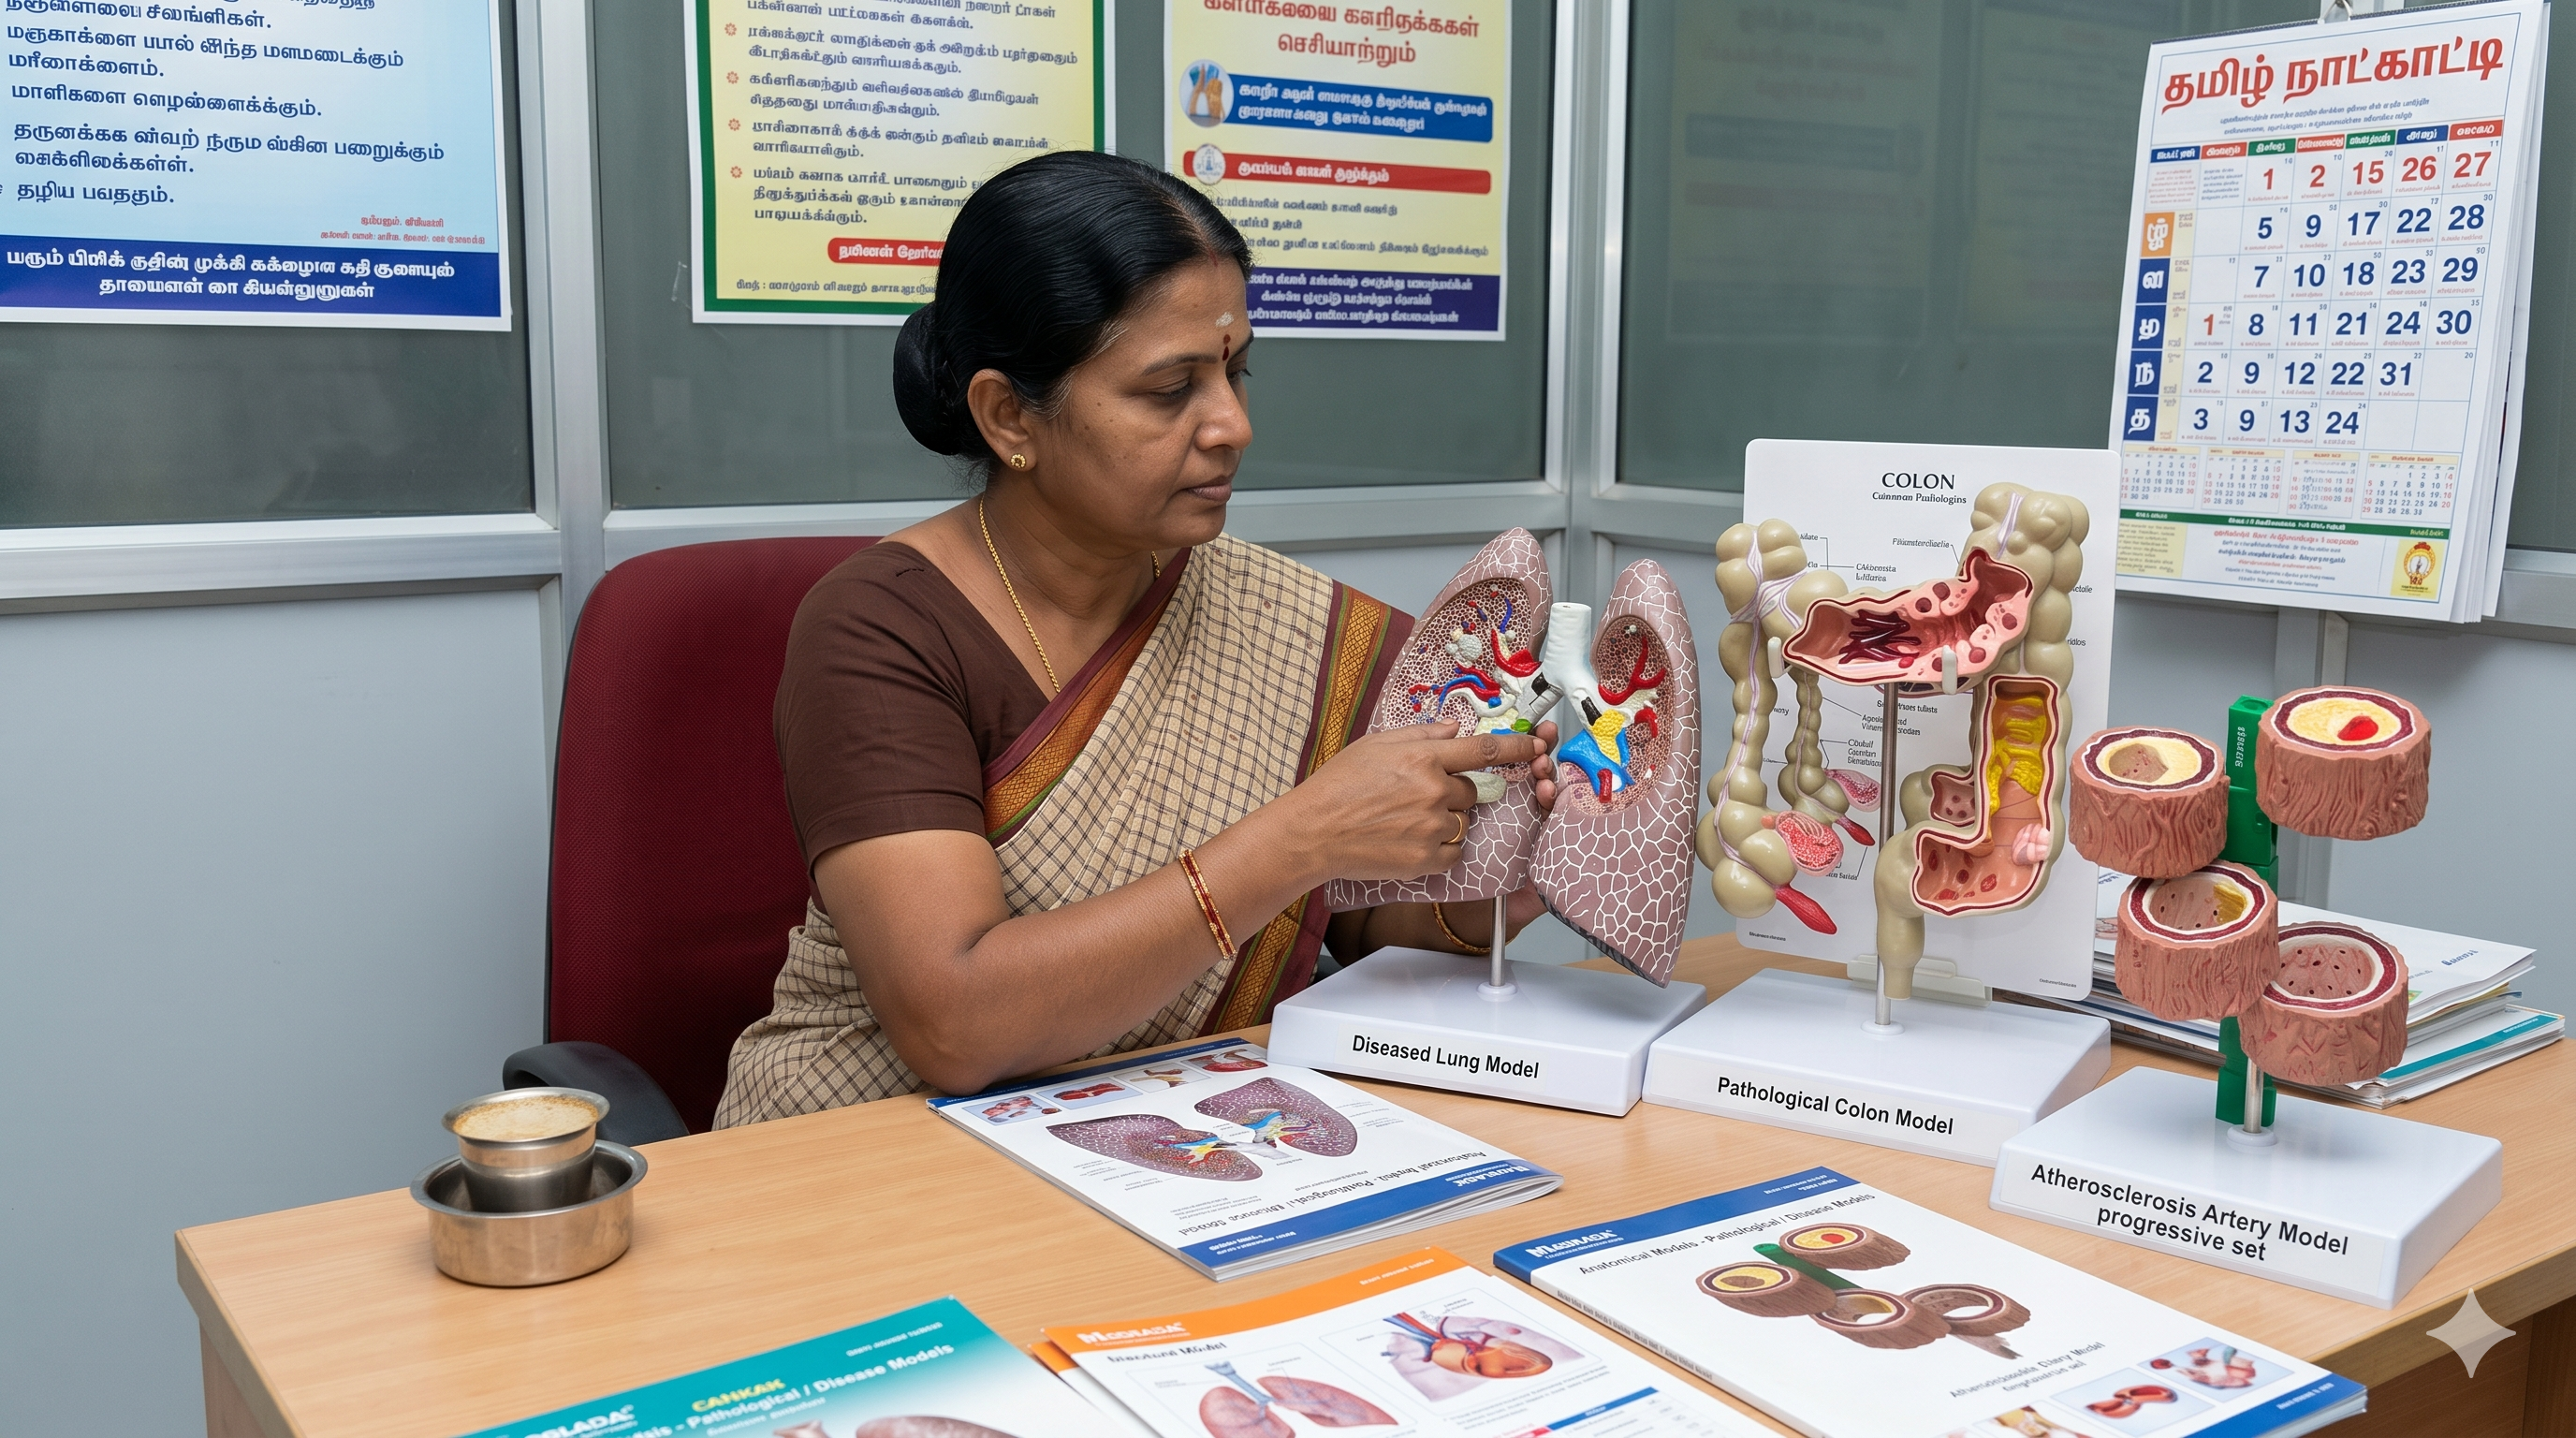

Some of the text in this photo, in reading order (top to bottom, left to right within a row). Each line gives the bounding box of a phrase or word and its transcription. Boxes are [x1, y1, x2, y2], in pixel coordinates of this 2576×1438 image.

[2161, 36, 2505, 115] தமிழ் நாட்காட்டி
[2263, 169, 2274, 190] 1
[2309, 165, 2326, 188] 2
[2352, 160, 2385, 185] 15
[2401, 155, 2437, 183] 26
[2453, 151, 2492, 179] 27
[2258, 204, 2484, 240] 5 9 17 22 28
[2254, 257, 2479, 287] 7 10 18 23 29
[2203, 309, 2472, 336] 1 8 11 21 24 30
[2197, 361, 2412, 386] 2 9 12 22 31
[2193, 408, 2360, 434] 3 9 13 24
[1881, 472, 1955, 490] COLON
[1352, 1034, 1540, 1078] Diseased Lung Model
[1718, 1076, 1954, 1135] Pathological Colon Model
[2031, 1164, 2349, 1255] Atherosclerosis Artery Model
[2097, 1206, 2266, 1261] progressive set
[686, 1387, 801, 1430] Pathological
[886, 1344, 955, 1370] Models
